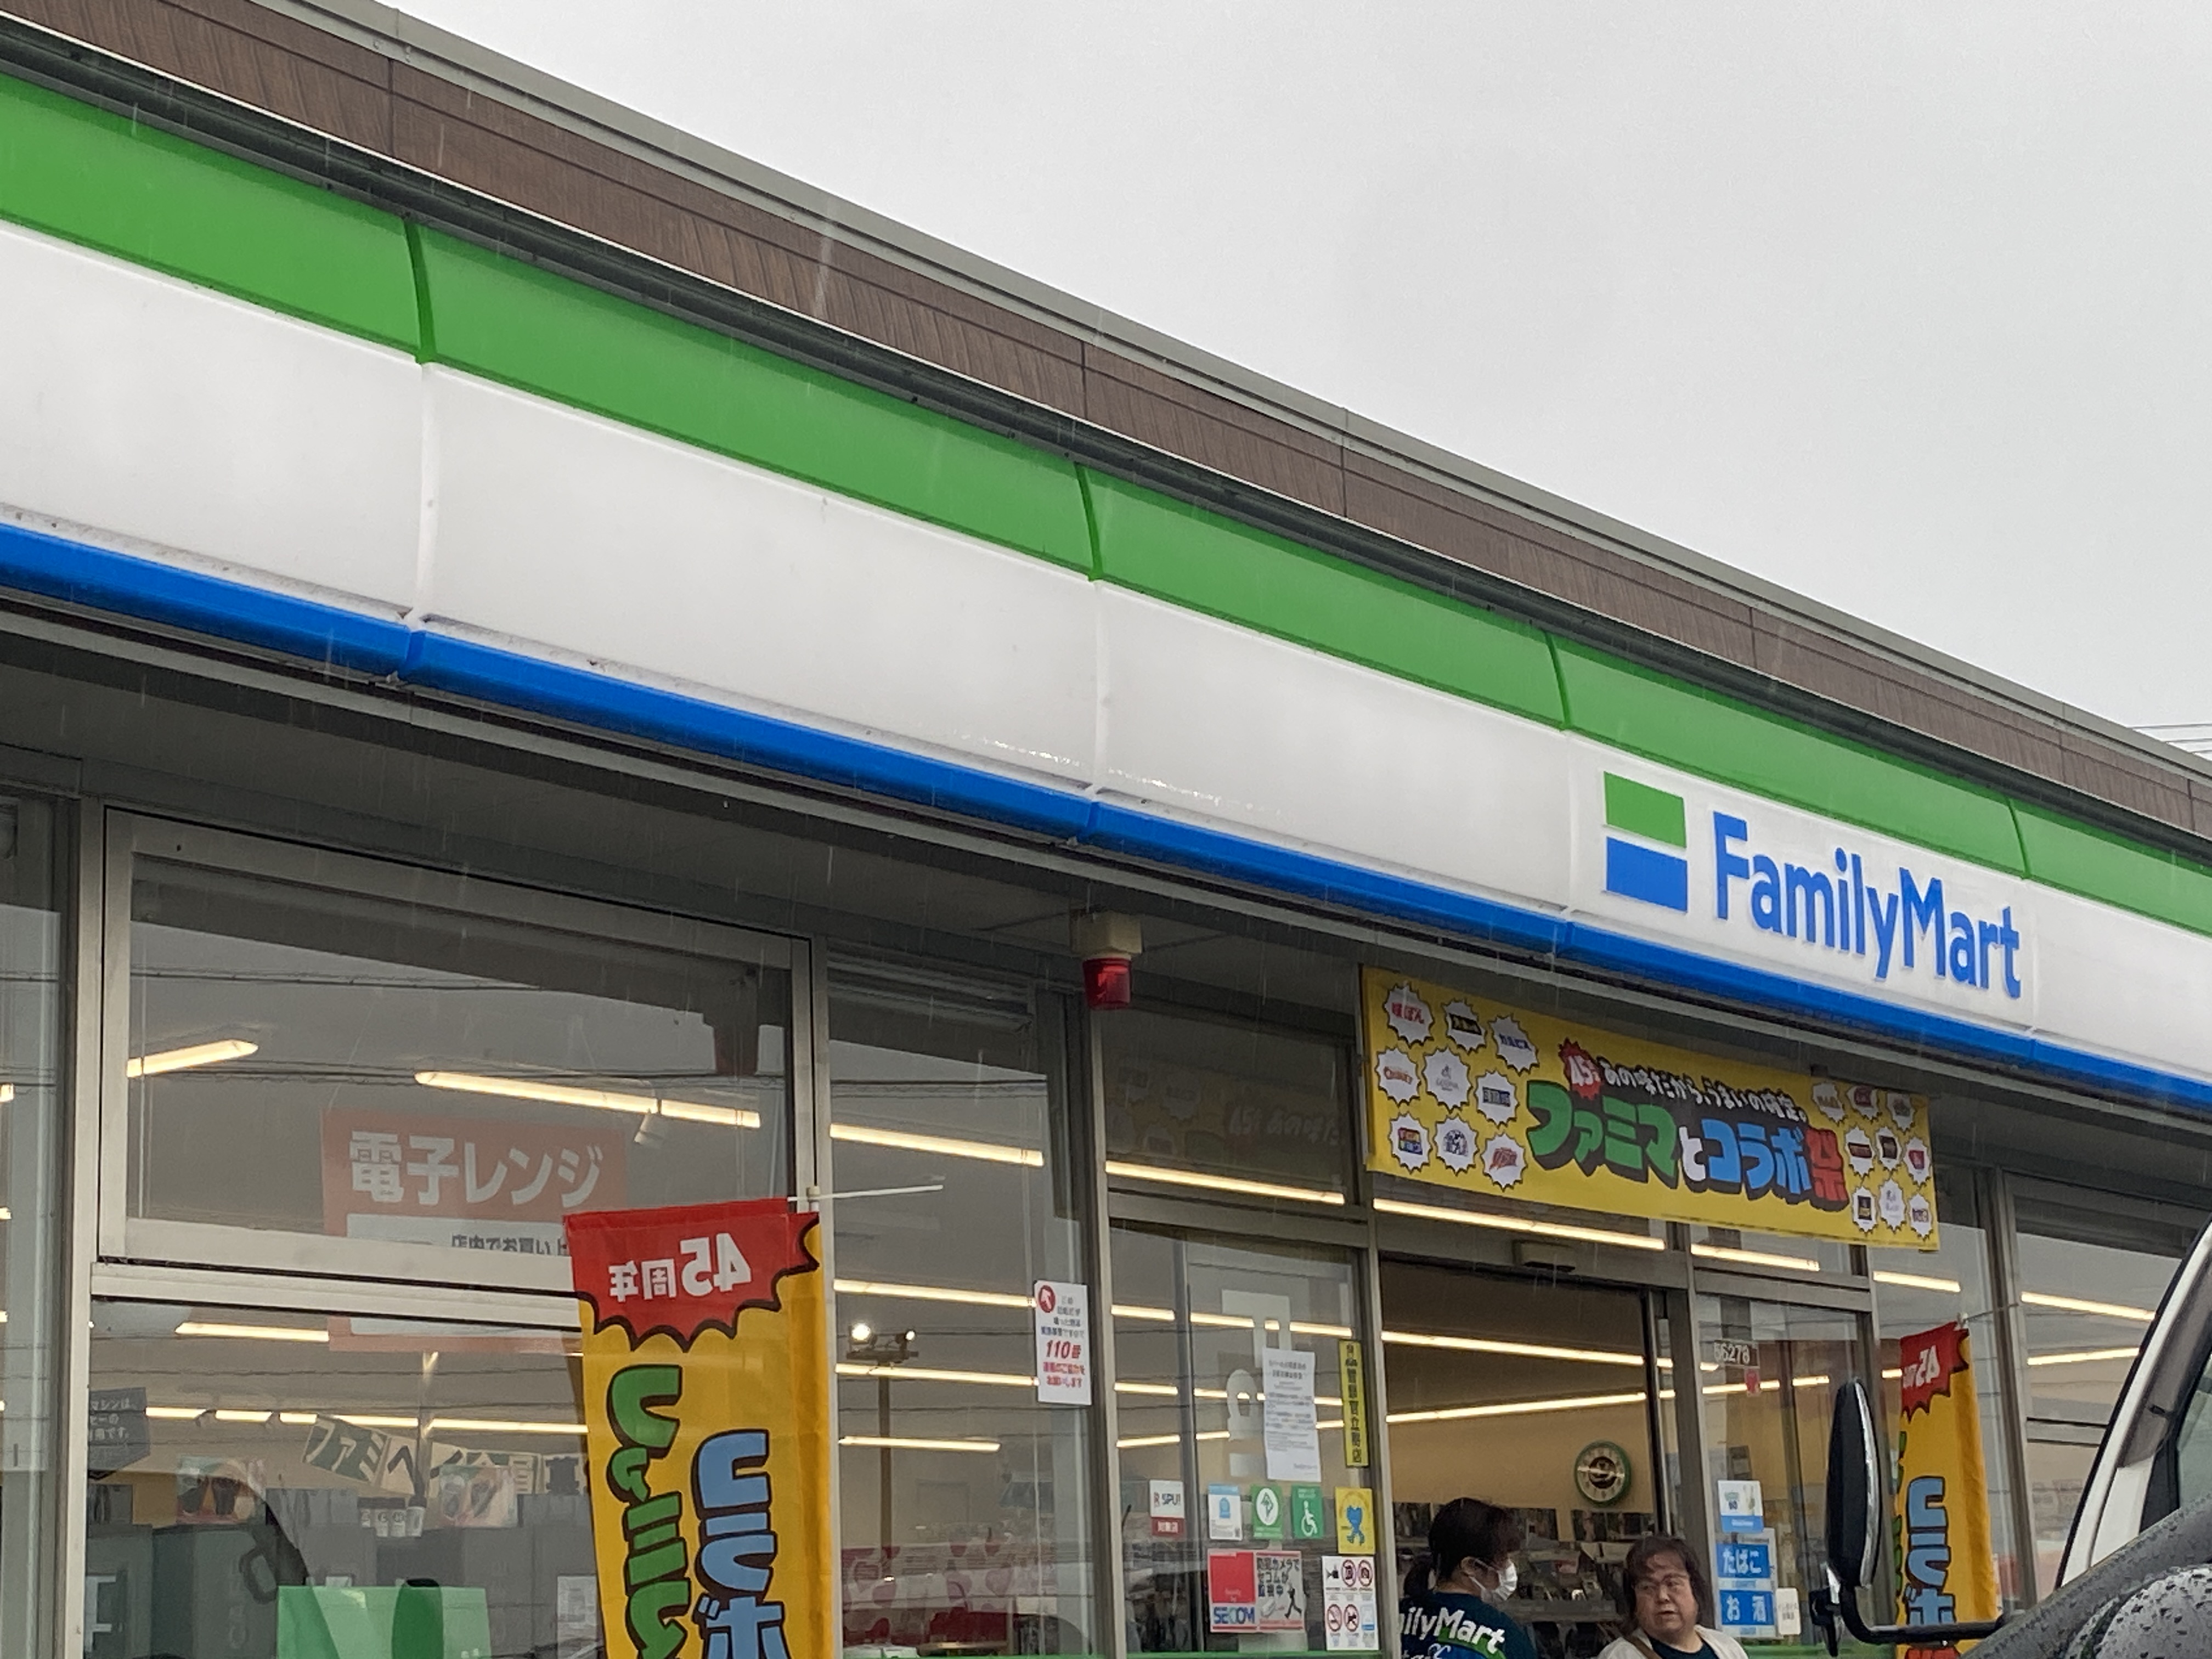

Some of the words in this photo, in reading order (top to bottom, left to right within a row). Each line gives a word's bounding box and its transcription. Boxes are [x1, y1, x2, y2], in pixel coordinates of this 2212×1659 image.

[1713, 811, 2021, 998] FamilyMart
[349, 1131, 603, 1207] 電子レンジ
[1527, 1081, 1850, 1203] ファミマとコラボ祭
[1723, 1548, 1762, 1575] たばこ
[1213, 1606, 1256, 1624] SECOM
